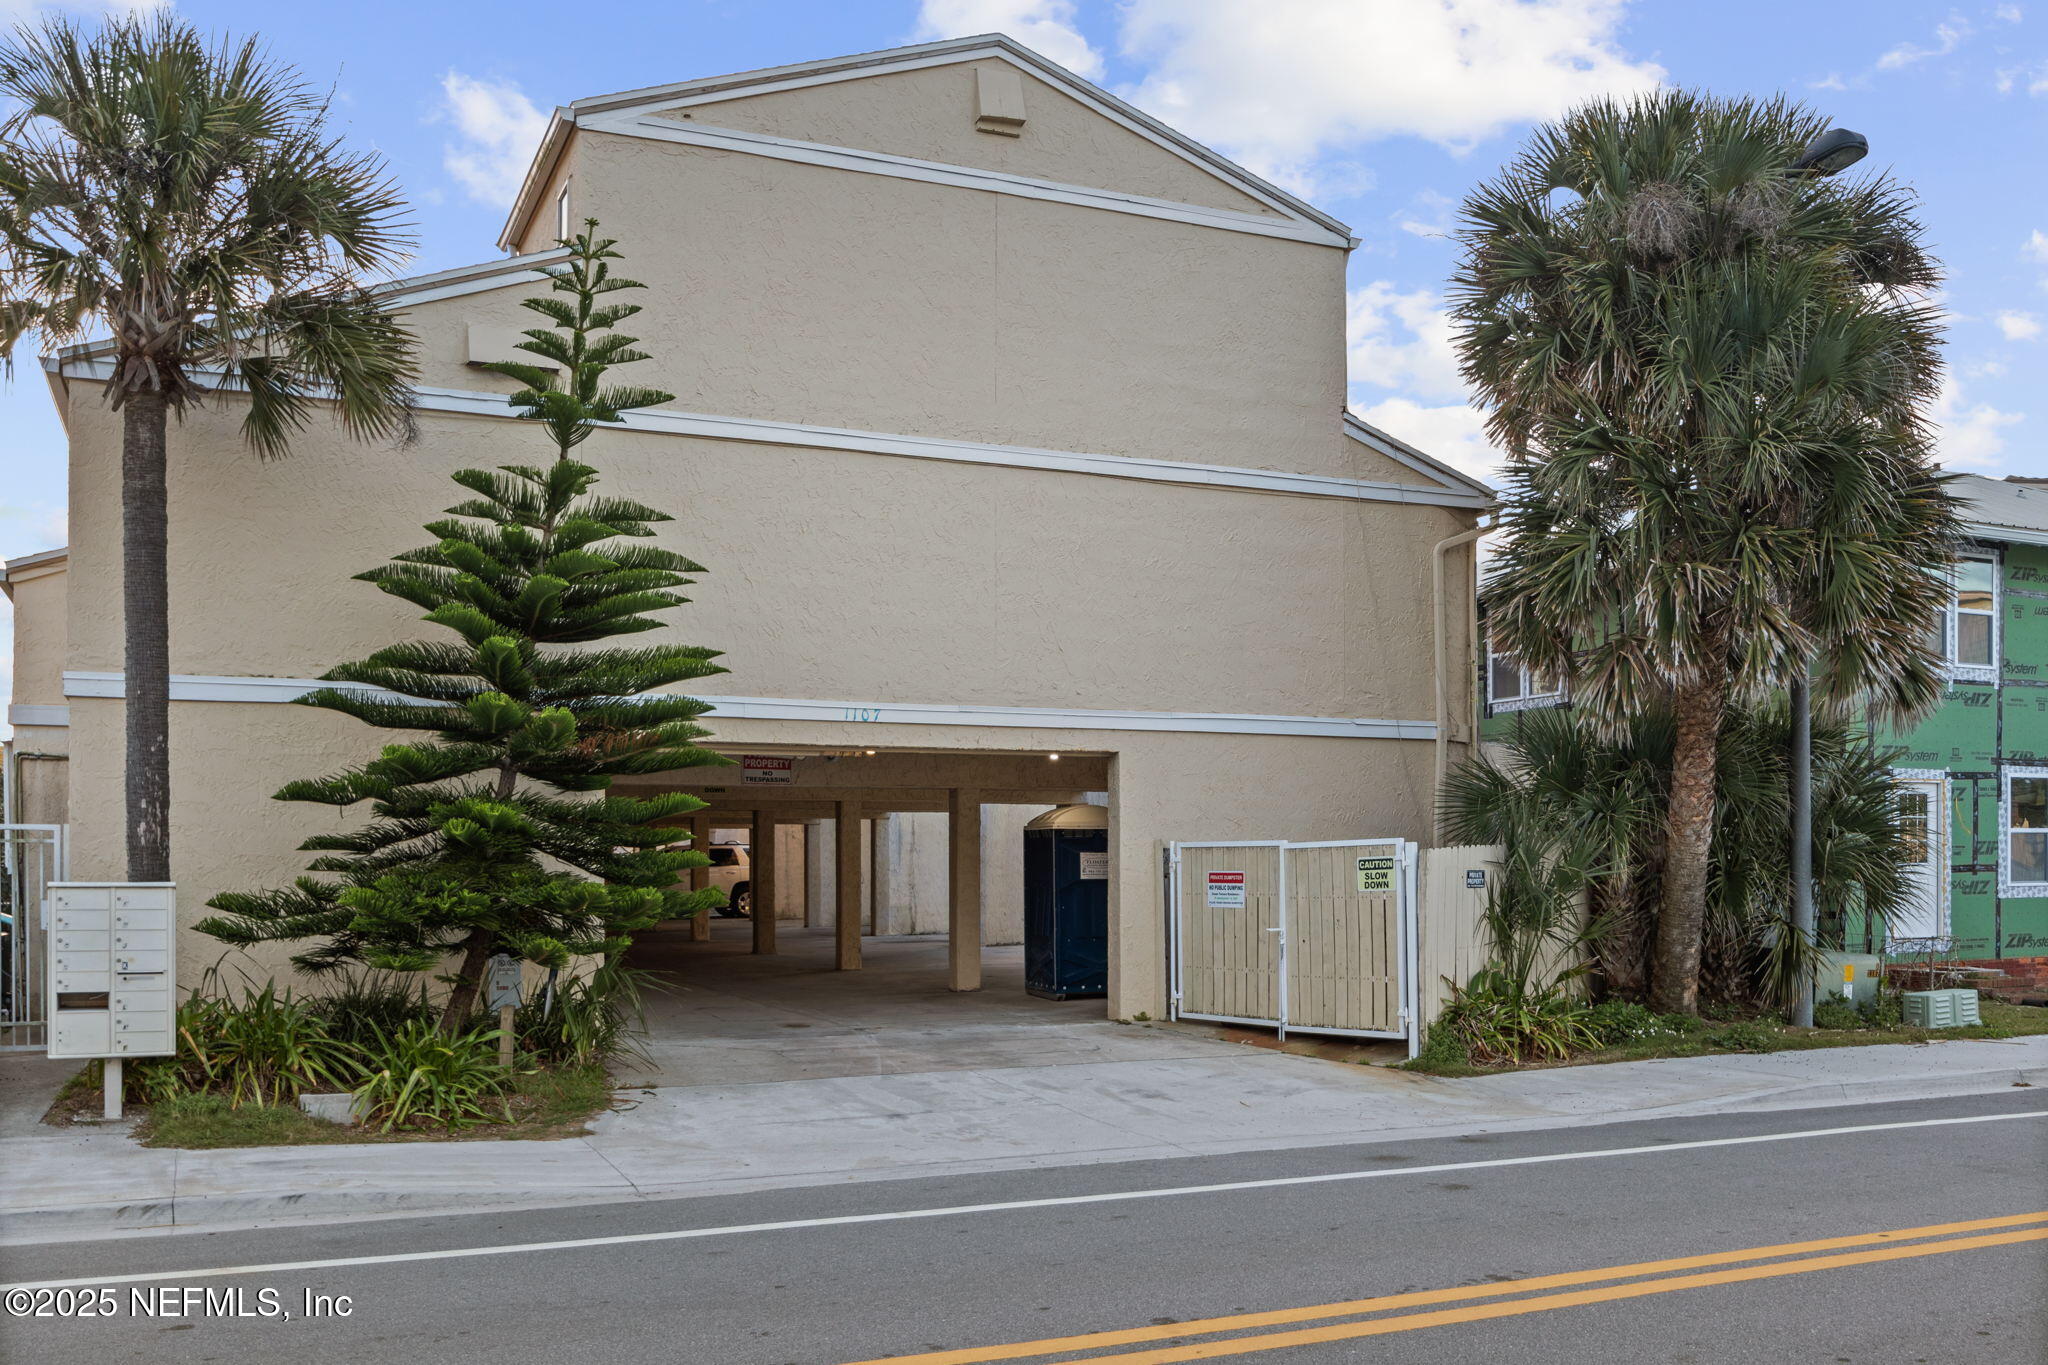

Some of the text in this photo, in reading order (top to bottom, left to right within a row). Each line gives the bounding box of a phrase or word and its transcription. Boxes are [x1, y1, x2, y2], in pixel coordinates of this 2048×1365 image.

[845, 707, 880, 722] 1107
[744, 758, 790, 769] PROPERTY
[1359, 860, 1392, 869] CAUTION
[1364, 871, 1388, 880] SLOW
[1364, 881, 1389, 889] DOWN
